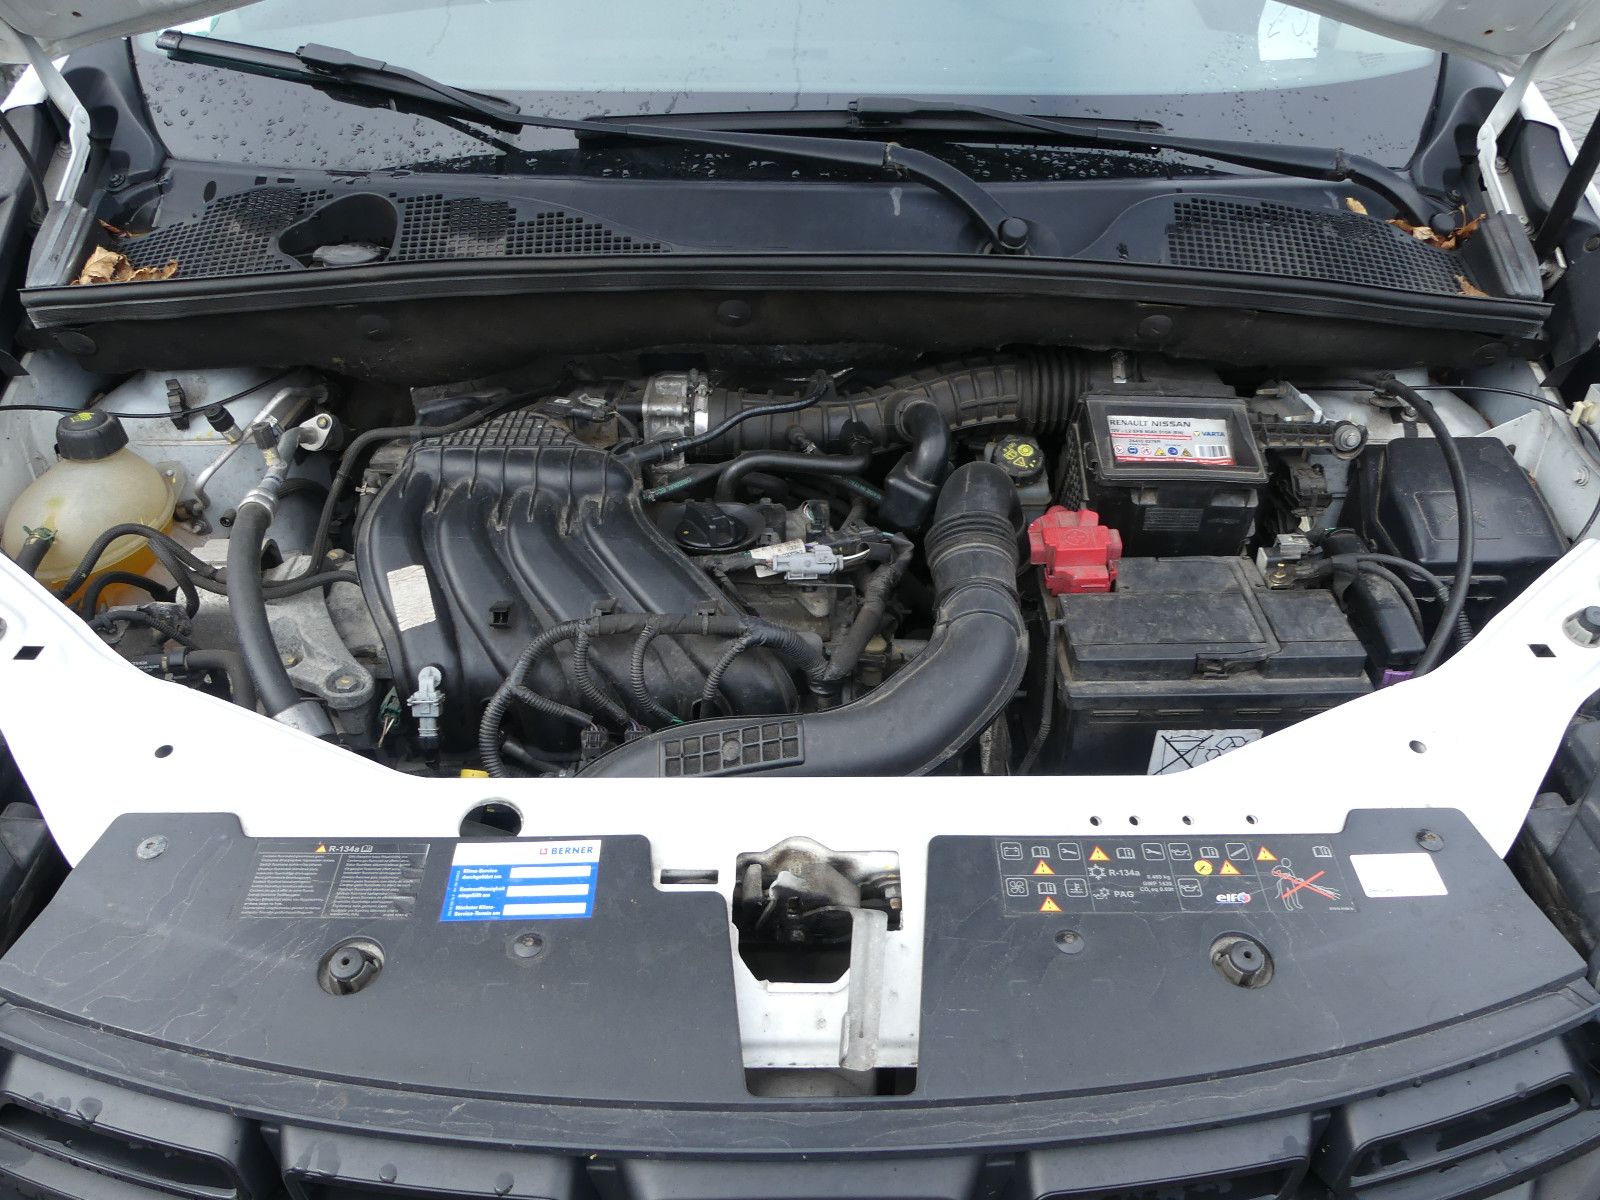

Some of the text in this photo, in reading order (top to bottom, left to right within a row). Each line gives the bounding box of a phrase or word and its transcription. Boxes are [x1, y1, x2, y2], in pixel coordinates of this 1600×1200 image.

[1110, 419, 1191, 428] RENAULT NISSAN
[328, 844, 361, 853] R-134a
[551, 845, 594, 855] BERNER
[1108, 868, 1141, 877] R-134a
[1113, 890, 1135, 898] PAG
[1215, 892, 1239, 902] elf
